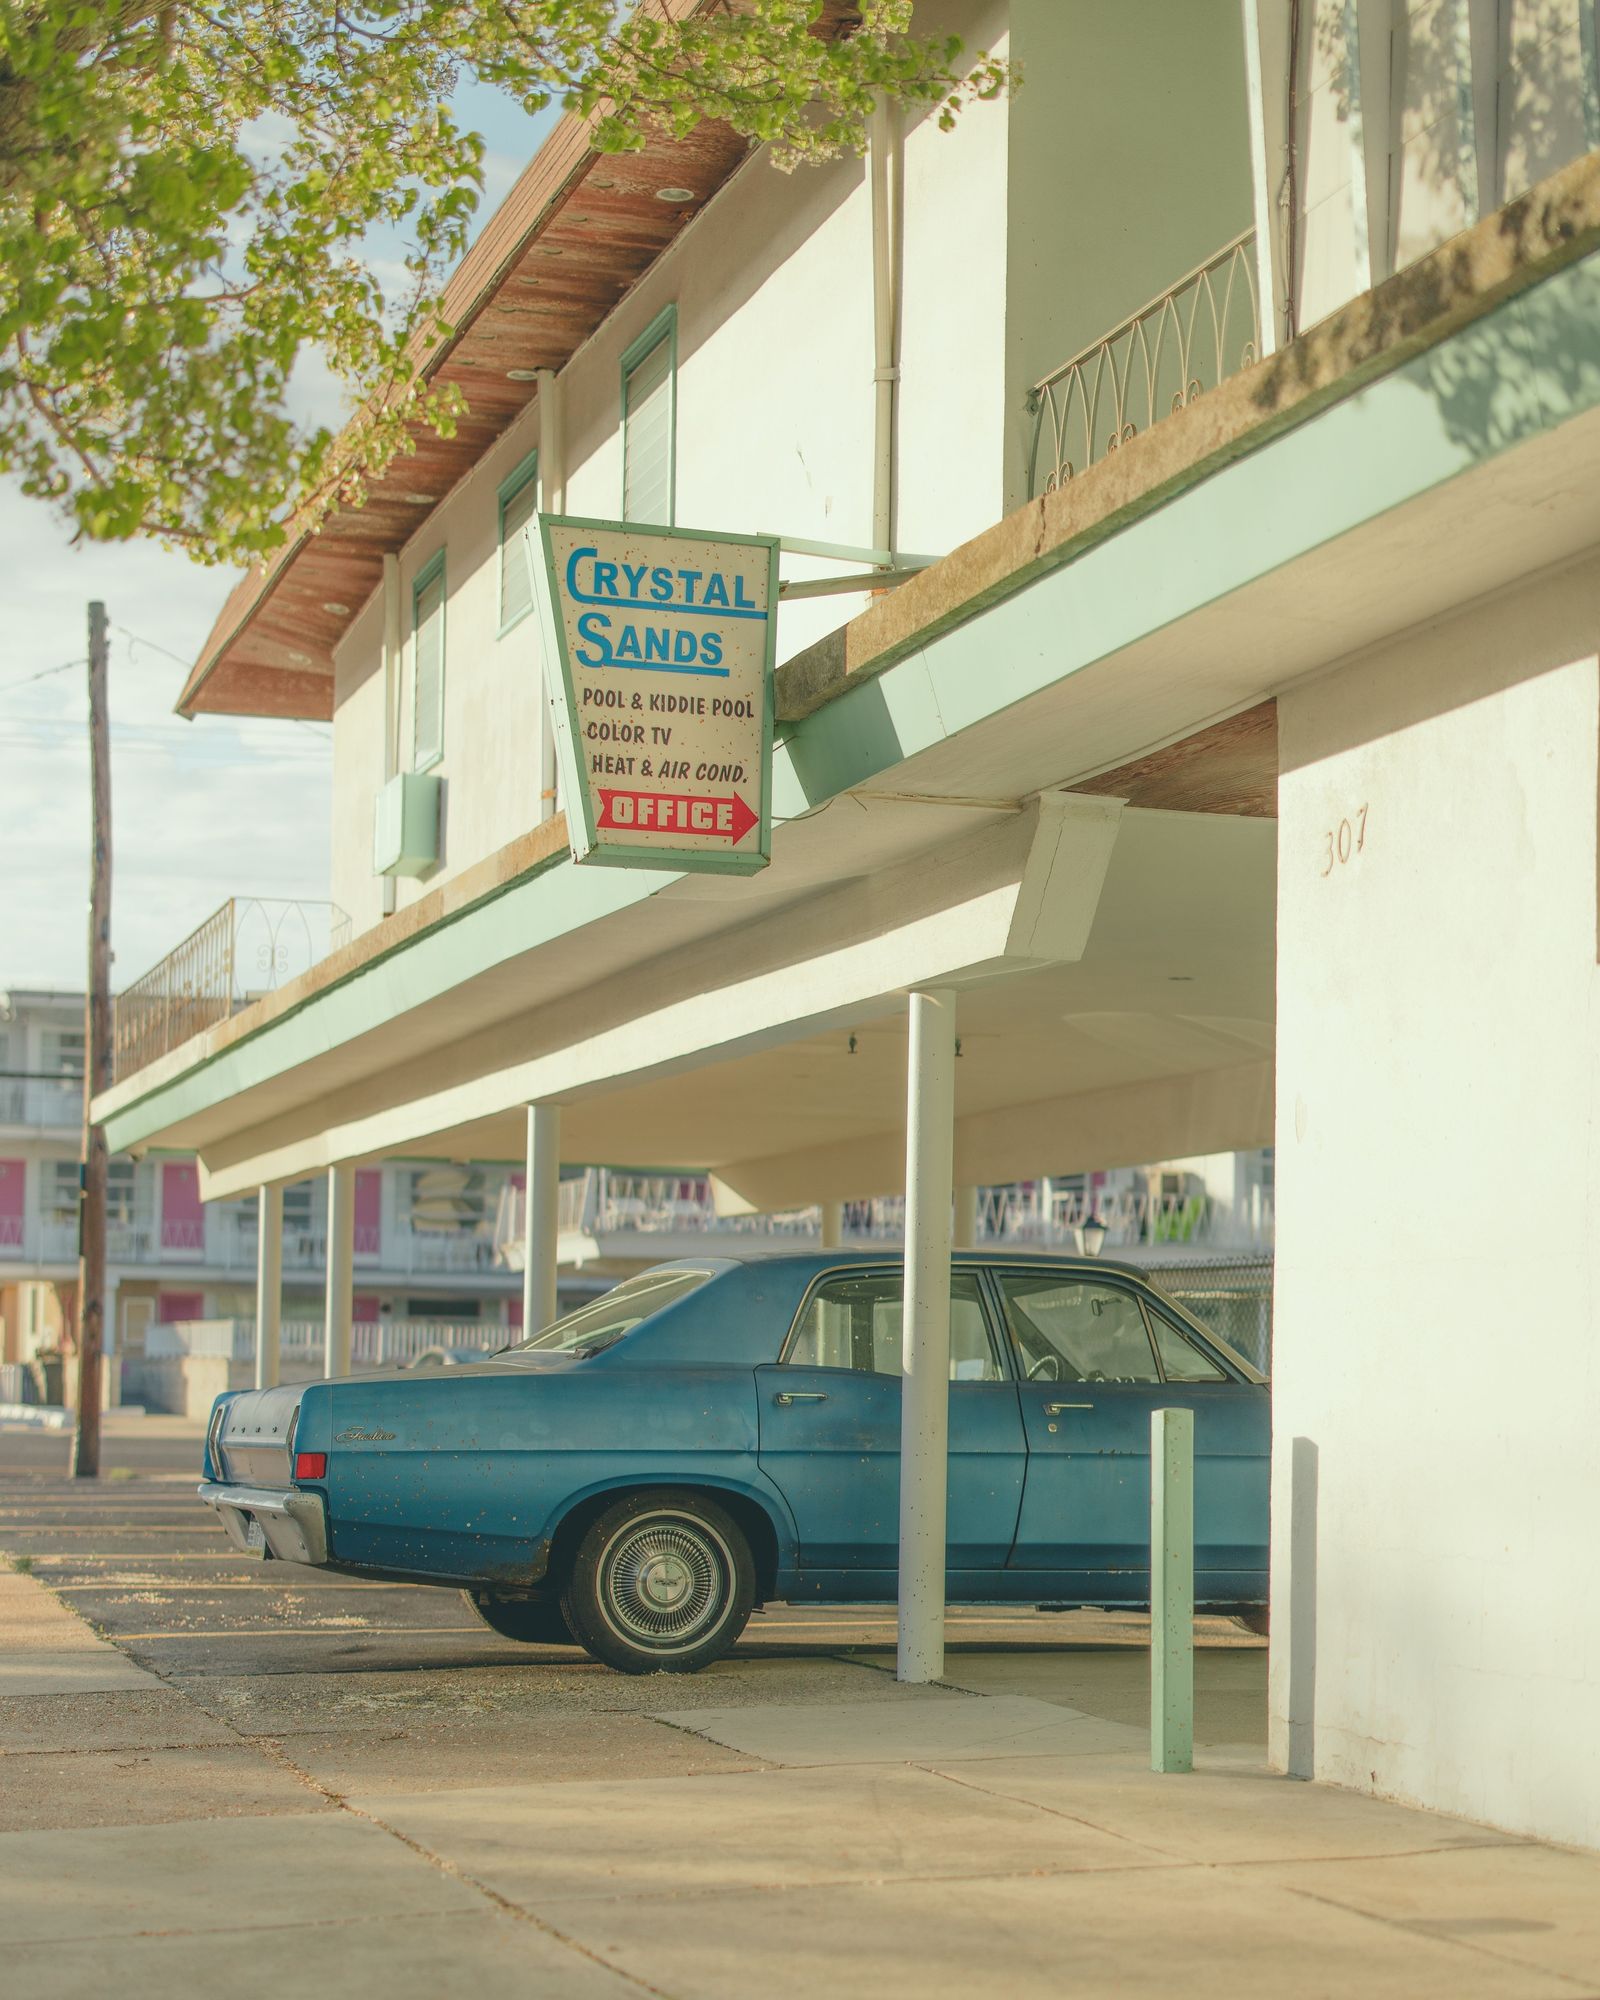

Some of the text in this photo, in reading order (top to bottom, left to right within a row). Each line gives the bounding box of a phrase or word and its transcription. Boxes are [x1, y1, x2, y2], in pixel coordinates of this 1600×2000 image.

[567, 547, 756, 609] CRYSTAL
[576, 612, 723, 668] SANDS
[583, 687, 754, 718] POOL & KIDDIE POOL
[586, 721, 672, 745] COLOR TV
[592, 754, 749, 784] HEAT & AIR COND.
[611, 796, 734, 831] OFFICE
